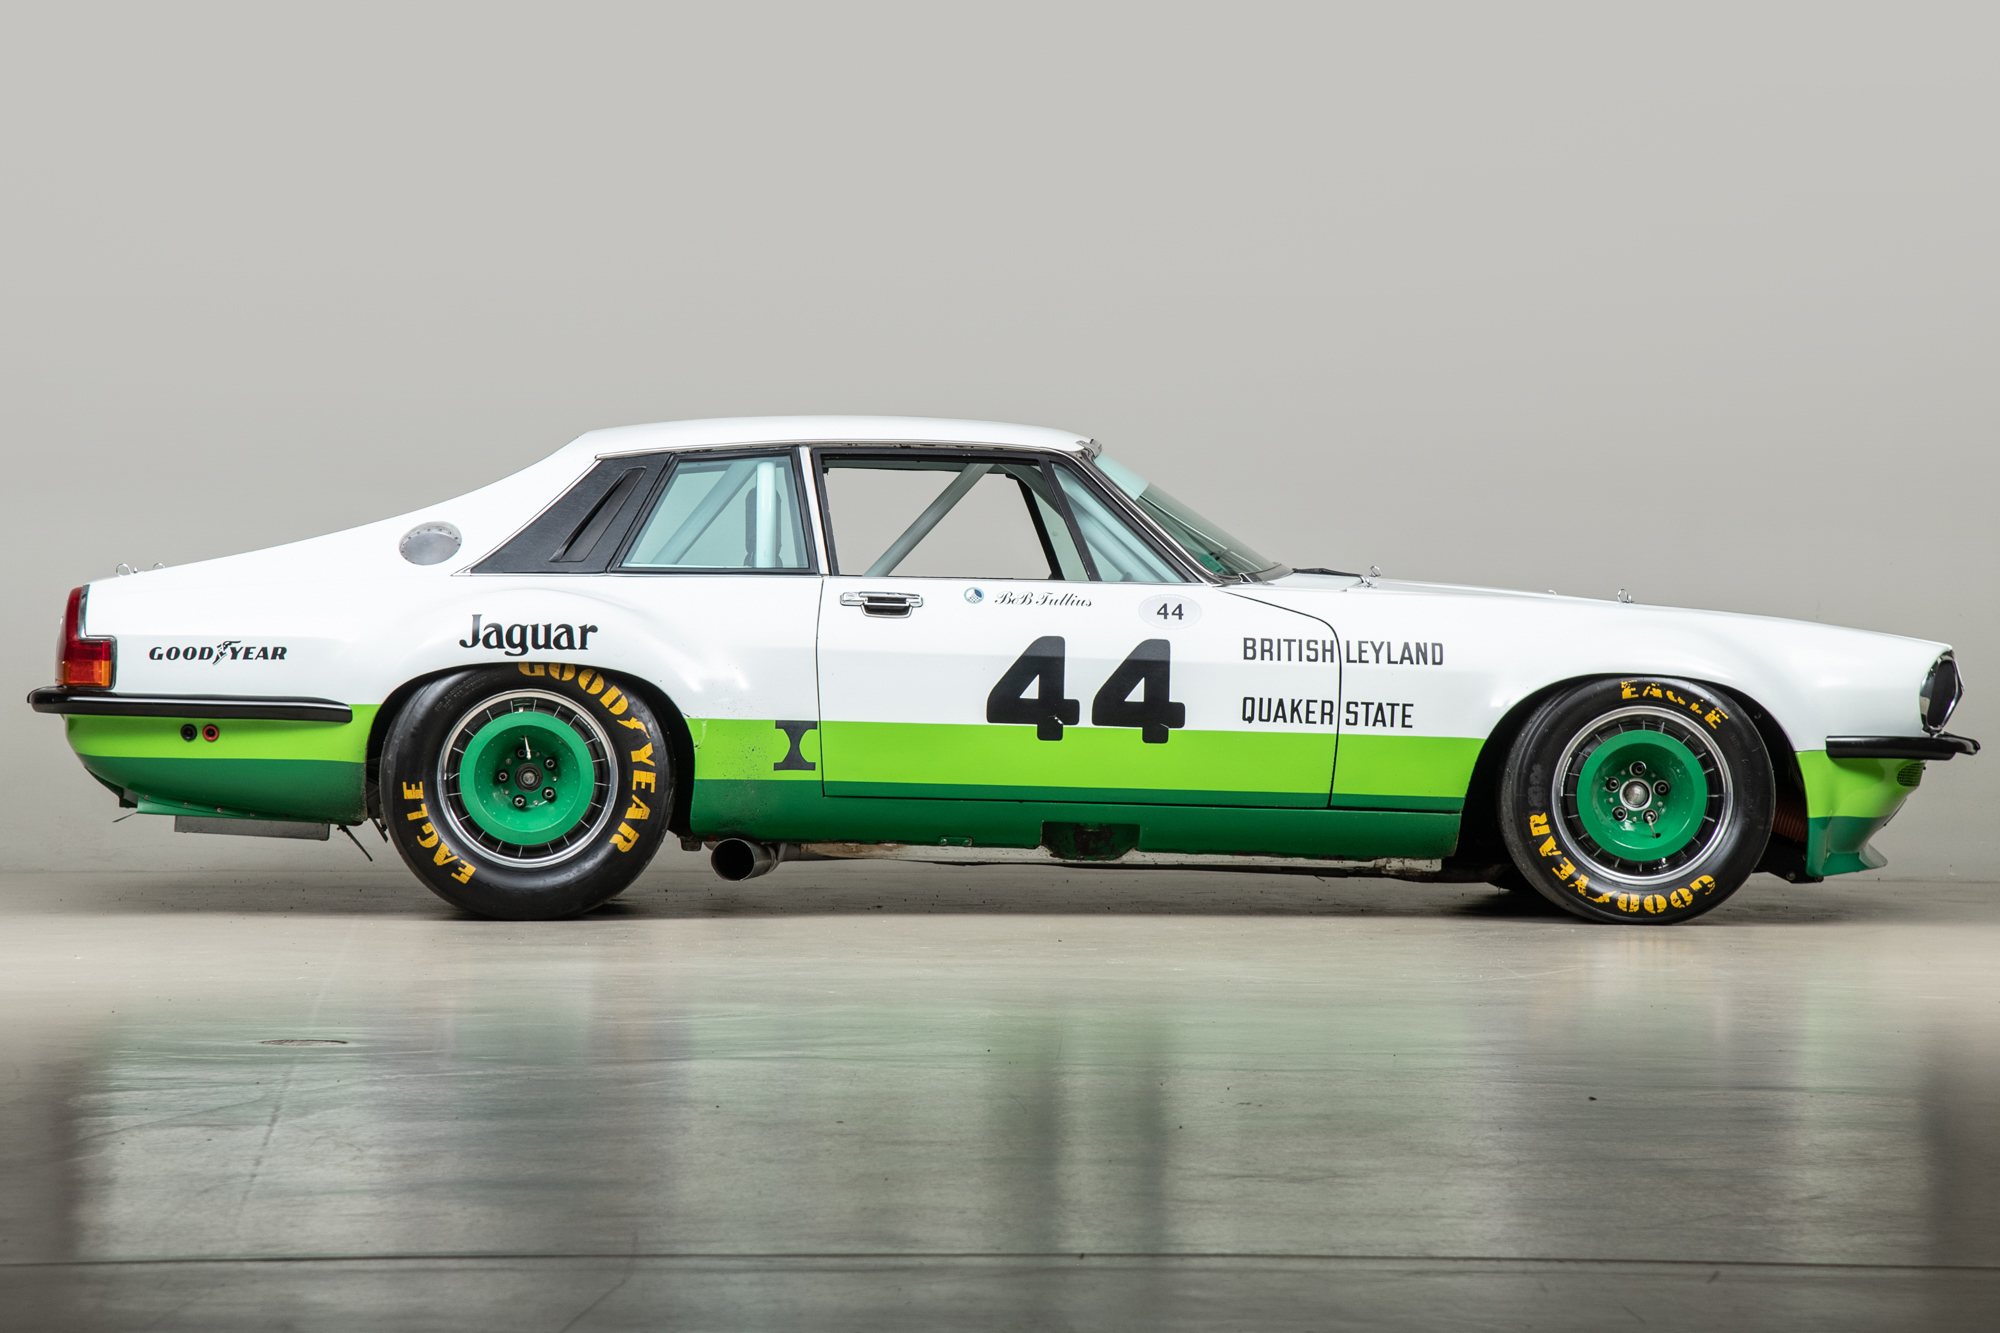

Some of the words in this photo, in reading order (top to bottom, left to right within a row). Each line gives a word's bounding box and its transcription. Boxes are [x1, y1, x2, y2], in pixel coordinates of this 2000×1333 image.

[1035, 592, 1092, 607] Tullius
[1156, 603, 1184, 620] 44
[459, 614, 599, 657] Jaguar
[1242, 637, 1336, 663] BRITISH
[1346, 640, 1444, 666] LEYLAND
[986, 635, 1186, 743] 44
[1241, 696, 1334, 725] QUAKER
[1345, 701, 1415, 729] STATE
[402, 780, 477, 885] EAGLE
